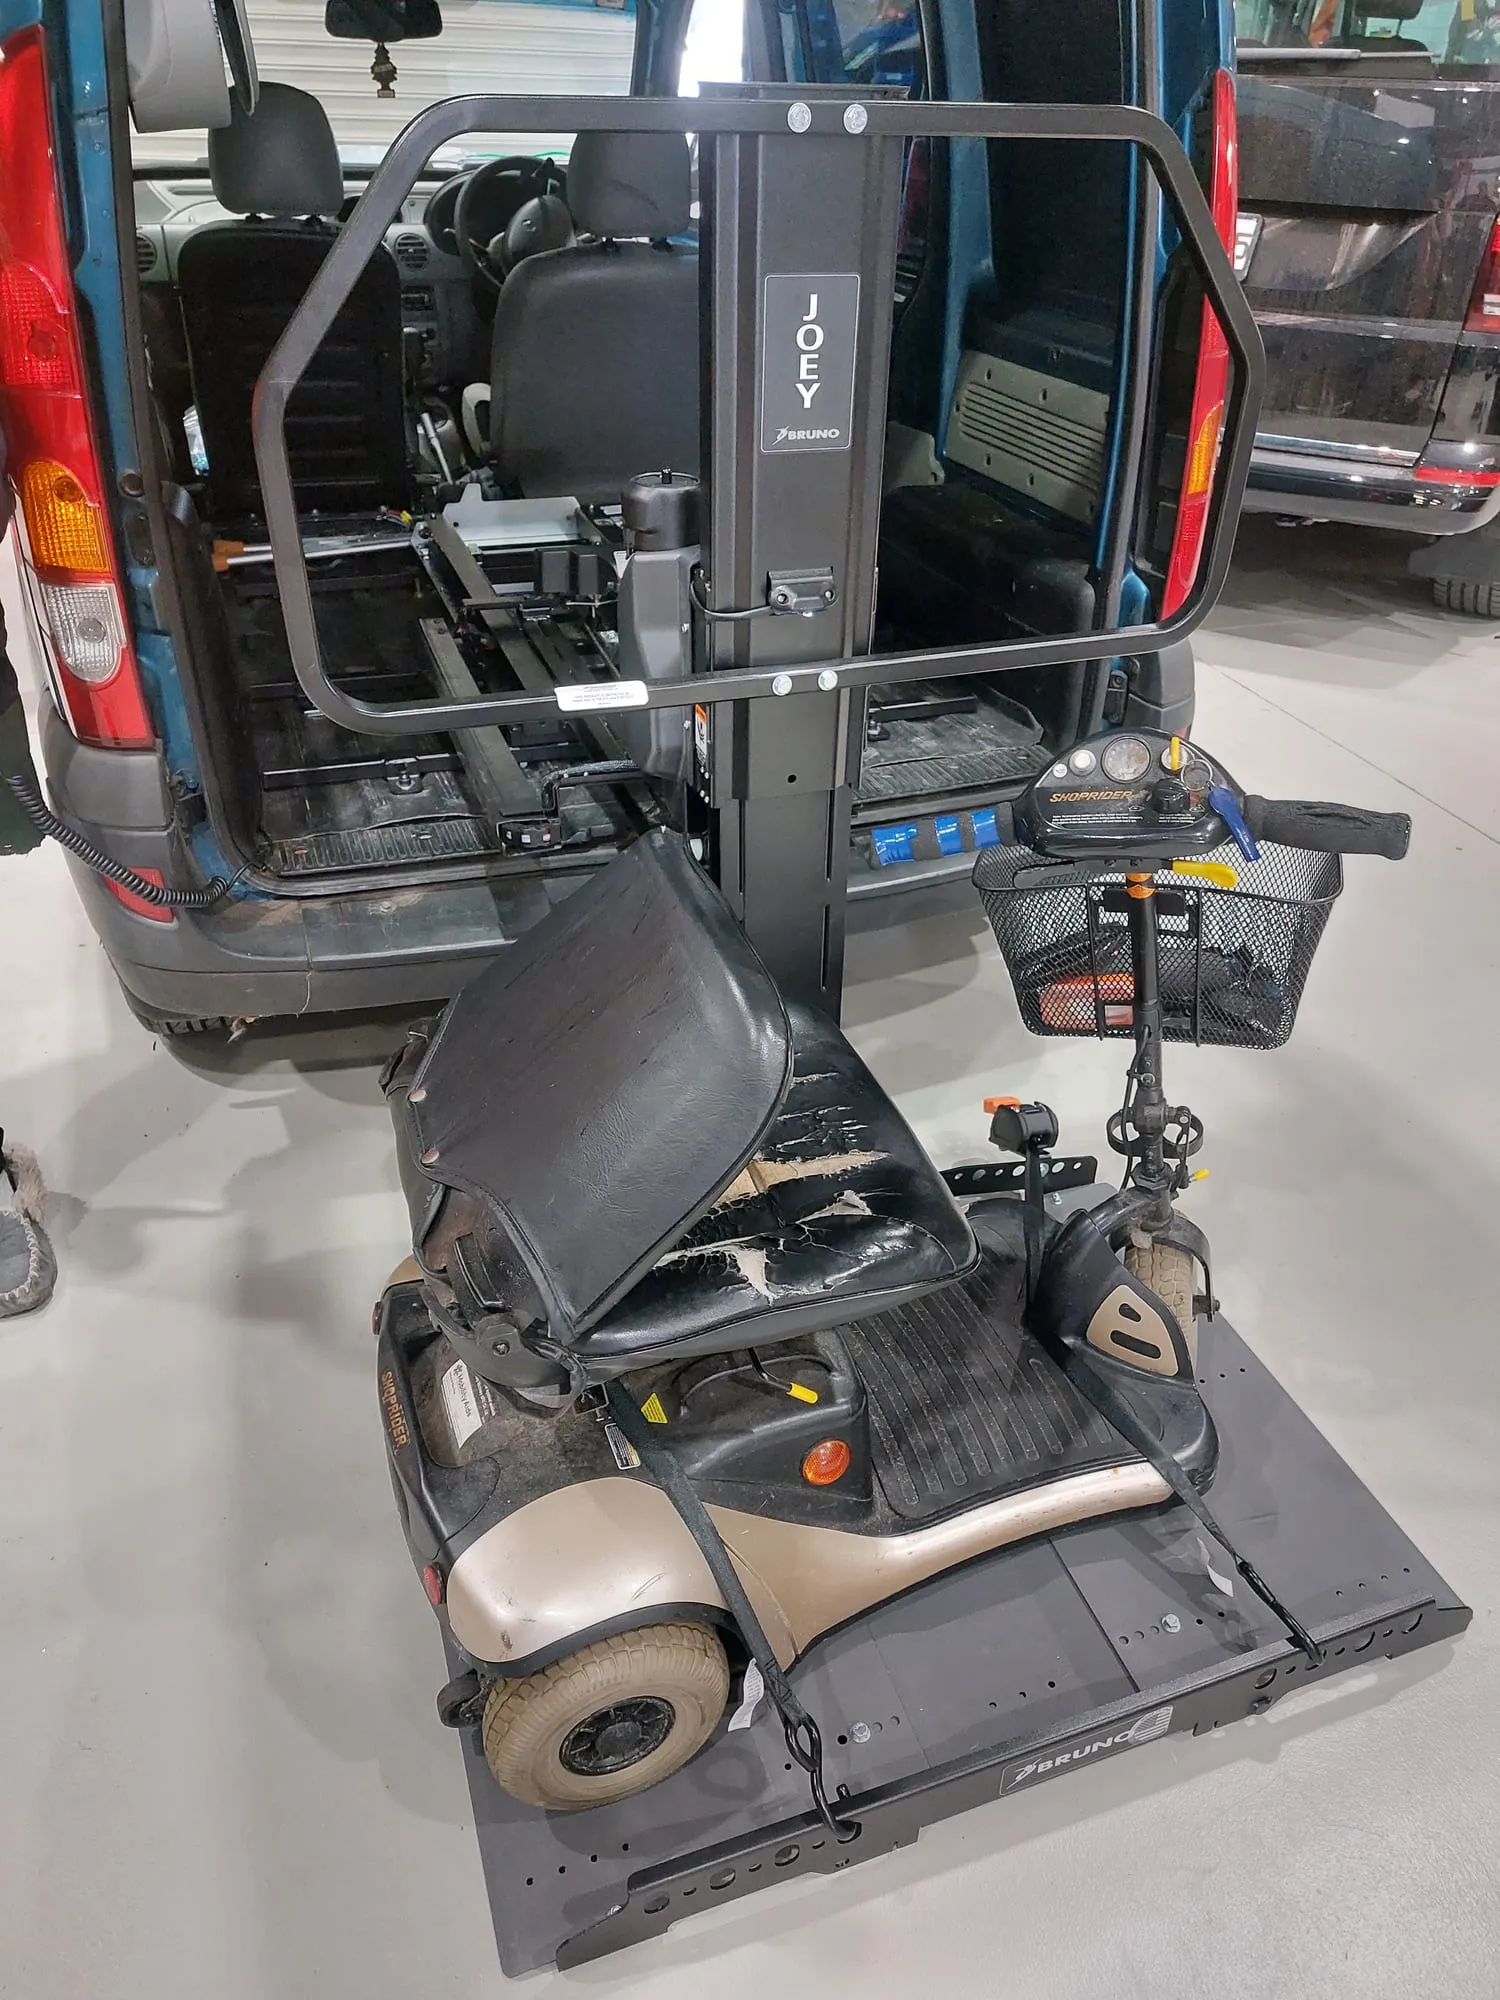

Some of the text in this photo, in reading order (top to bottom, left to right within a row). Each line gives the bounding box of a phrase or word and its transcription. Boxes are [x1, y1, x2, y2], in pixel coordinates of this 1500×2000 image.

[795, 293, 824, 409] JOEY
[787, 428, 840, 441] BRUNO
[1050, 789, 1133, 803] SHOPRIDER
[381, 1371, 408, 1447] SHOPRIDER
[1037, 1730, 1133, 1774] BRUNO
